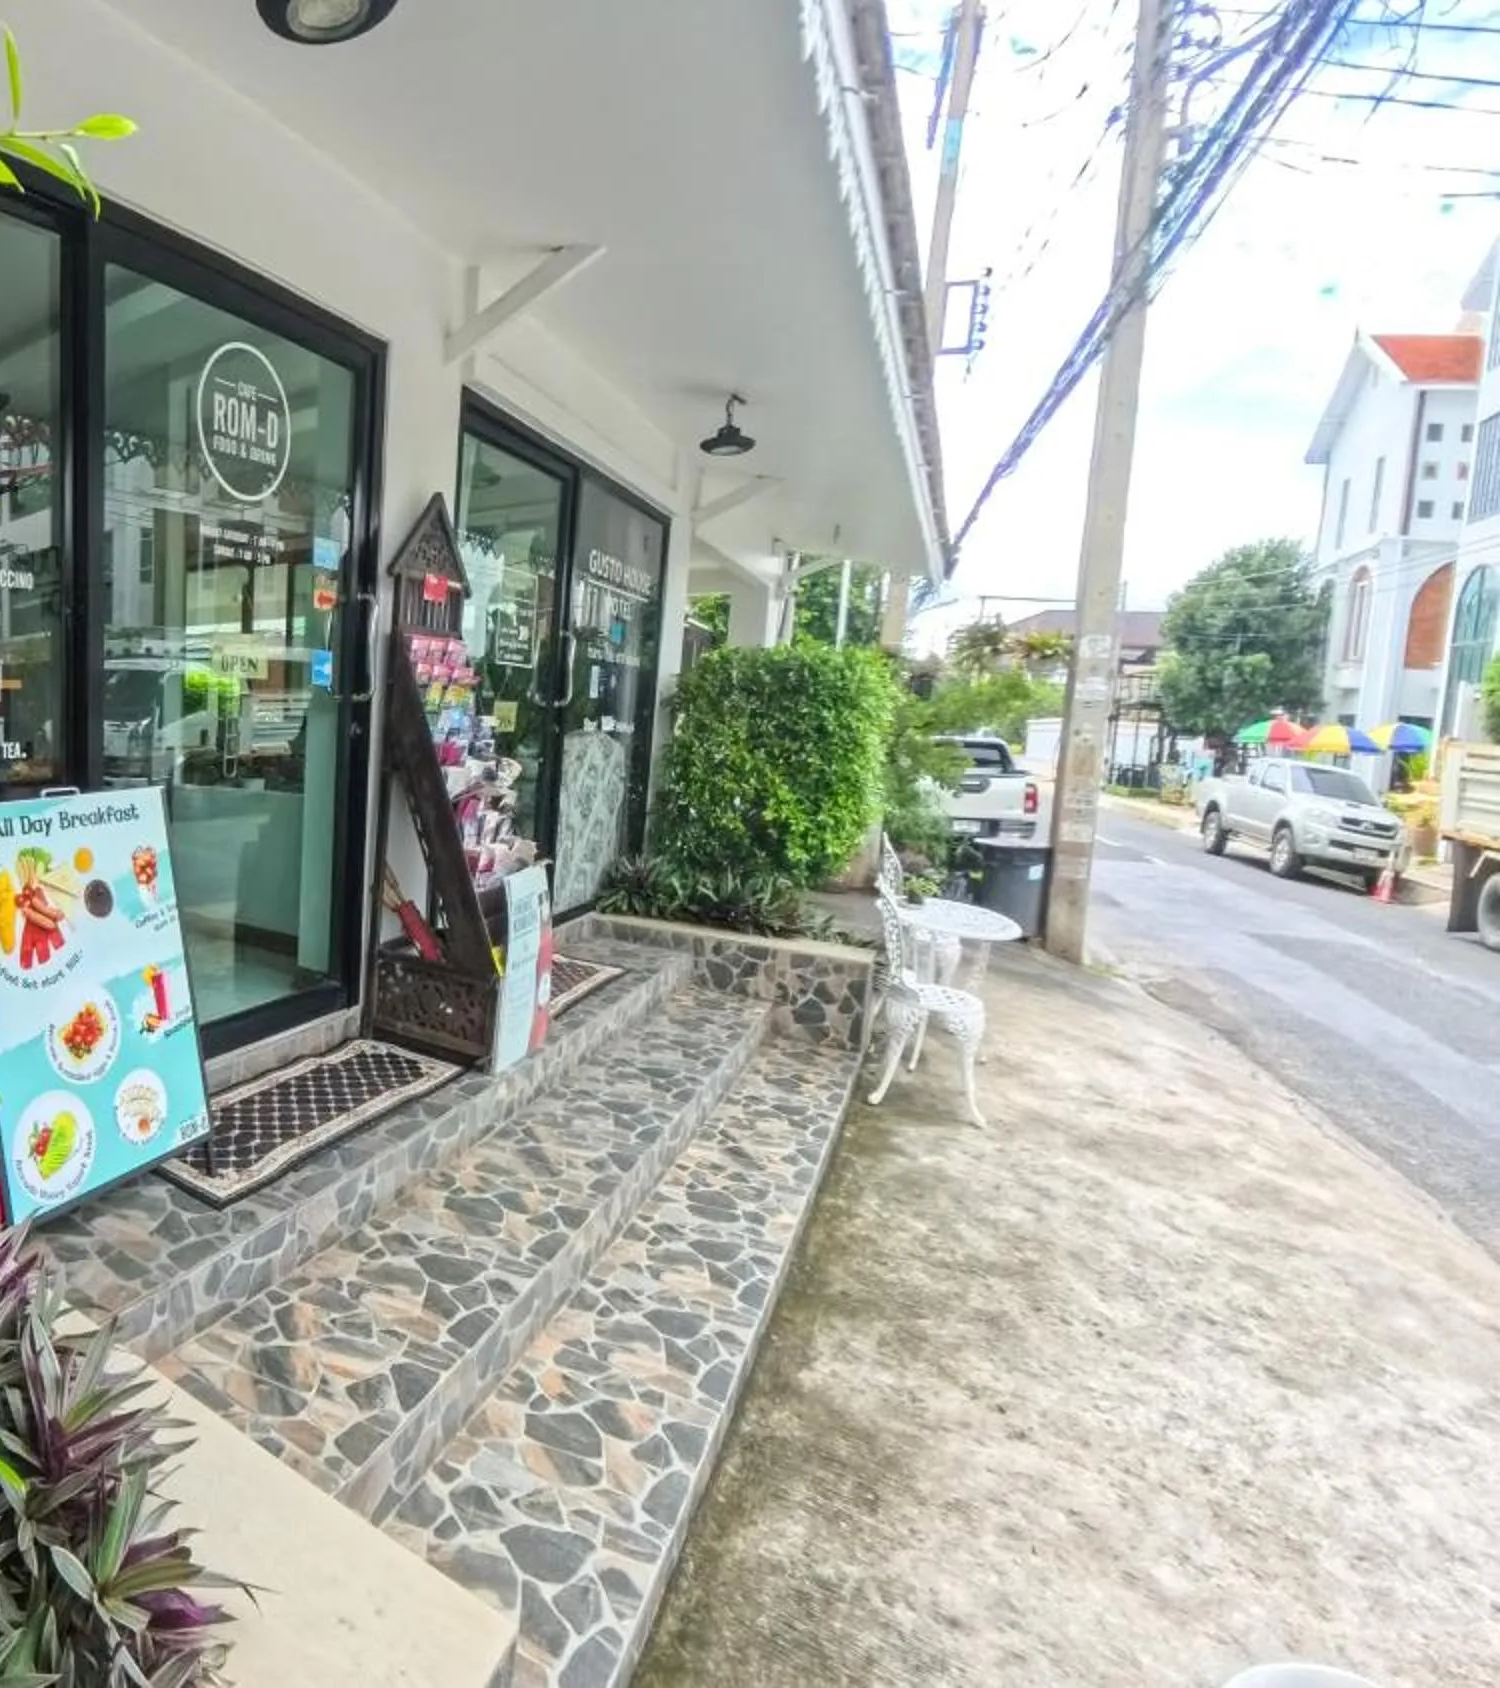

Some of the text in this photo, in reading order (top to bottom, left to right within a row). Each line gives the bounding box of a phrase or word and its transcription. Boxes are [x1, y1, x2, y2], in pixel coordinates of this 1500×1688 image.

[213, 391, 279, 449] ROM-D
[589, 549, 623, 584] GUSTO
[220, 656, 259, 673] OPEN
[19, 815, 52, 837] Day
[58, 803, 140, 831] Breakfast
